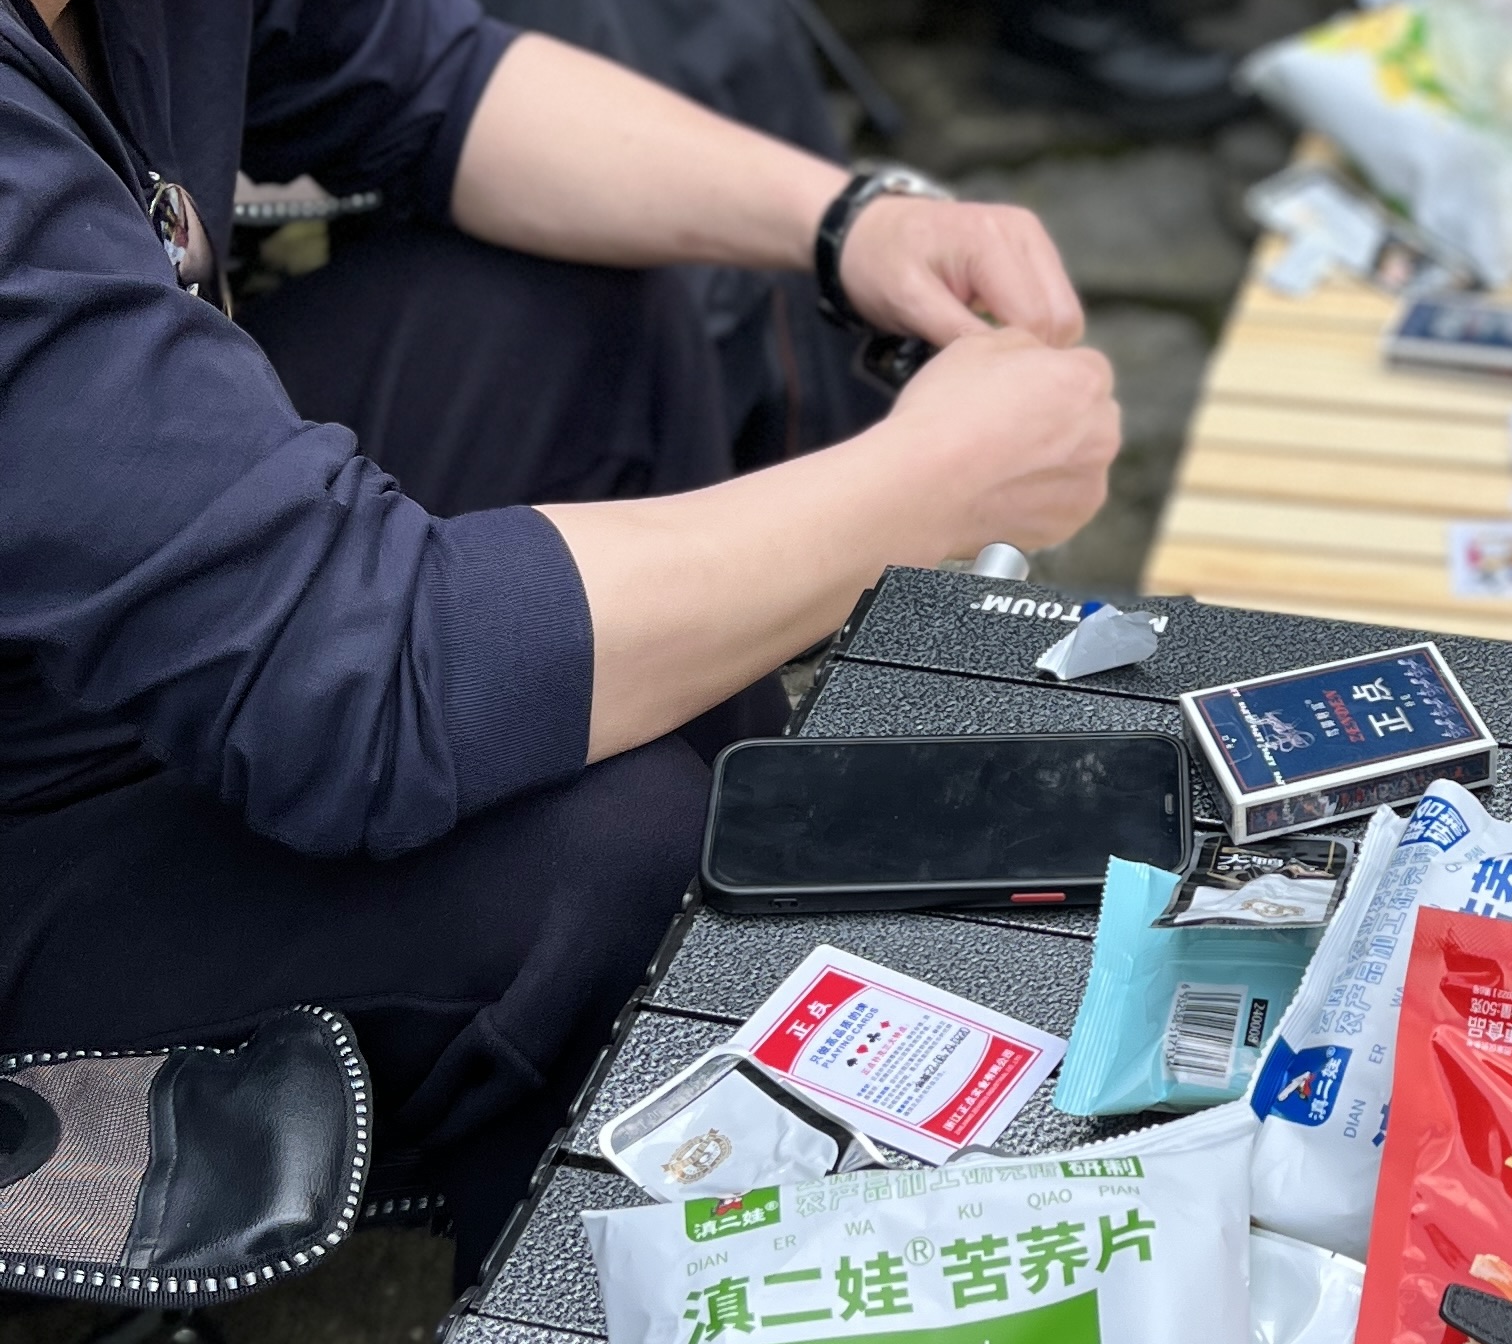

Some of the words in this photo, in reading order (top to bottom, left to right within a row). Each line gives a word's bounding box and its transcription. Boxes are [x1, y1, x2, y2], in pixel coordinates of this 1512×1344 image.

[785, 998, 833, 1041] 正点
[821, 1033, 855, 1069] PLAYING
[851, 1006, 879, 1036] CARDS
[1341, 1097, 1368, 1140] DIAN
[1368, 1042, 1388, 1065] ER
[687, 1252, 728, 1276] DIAN
[774, 1235, 796, 1251] ER
[845, 1220, 874, 1236] WA
[959, 1203, 983, 1219] KU
[1028, 1190, 1072, 1209] QIAO
[1099, 1185, 1140, 1196] PIAN
